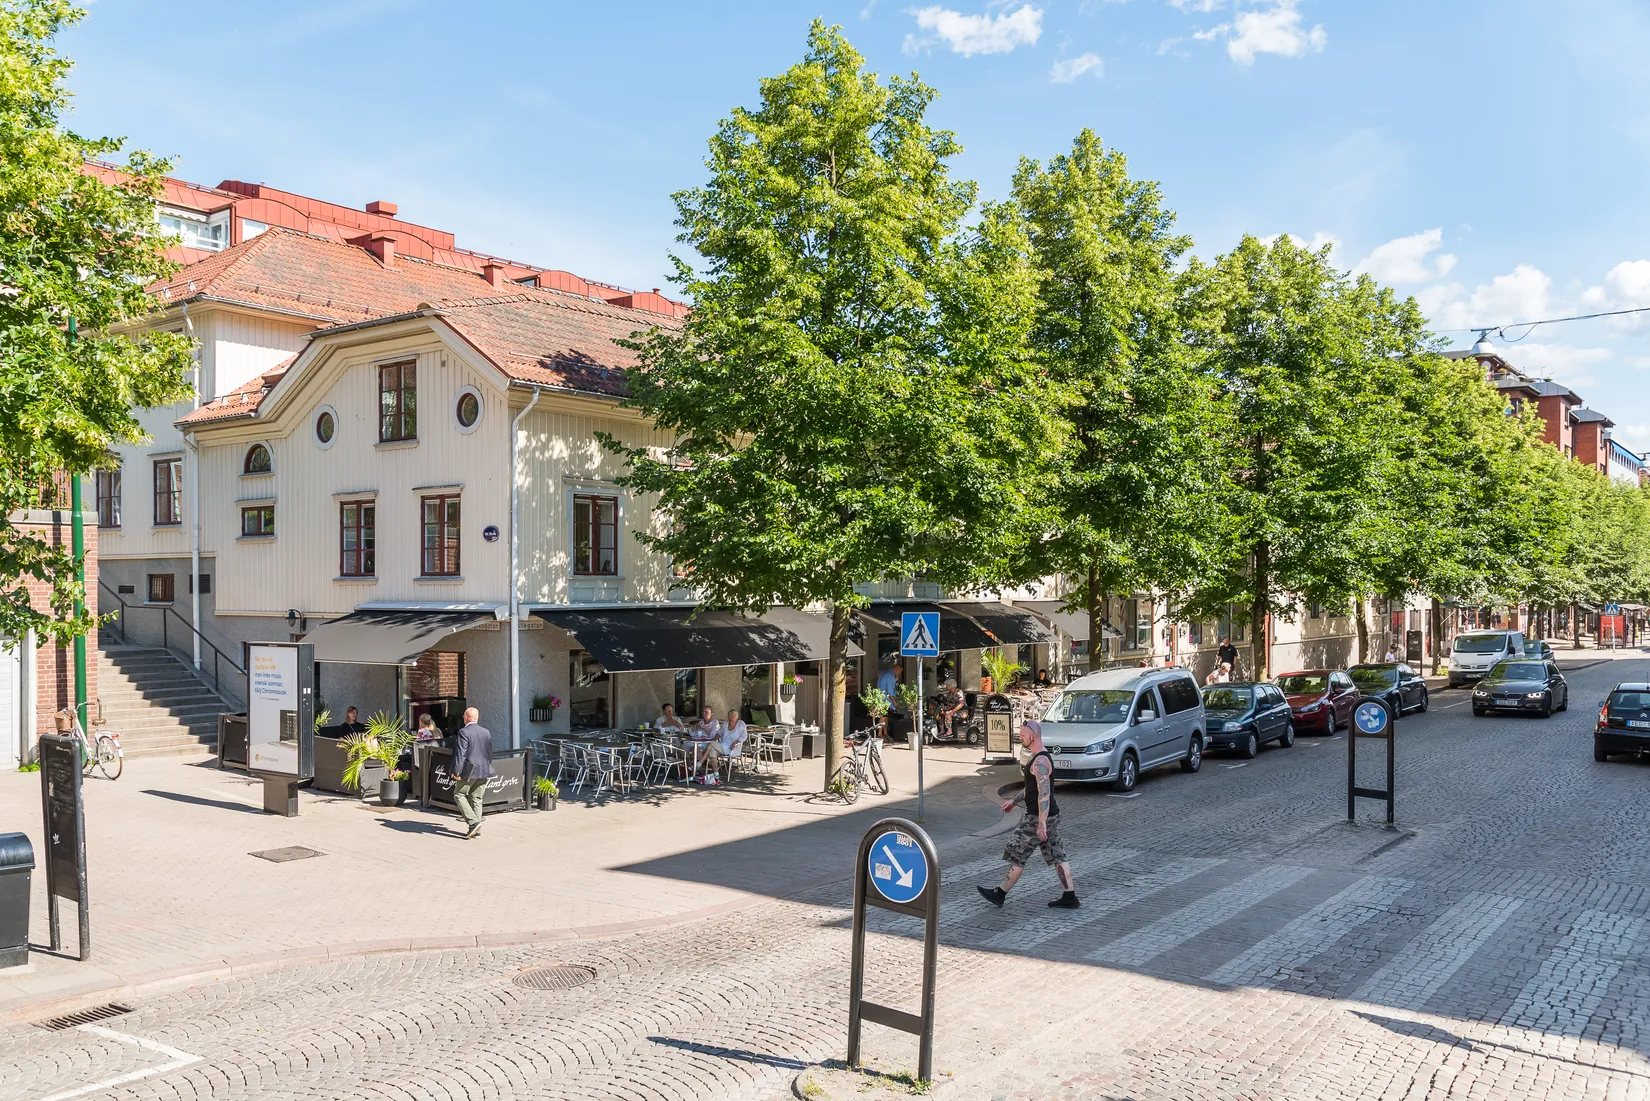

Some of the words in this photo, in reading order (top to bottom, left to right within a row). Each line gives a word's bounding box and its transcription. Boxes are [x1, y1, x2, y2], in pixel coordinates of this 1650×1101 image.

[991, 719, 1006, 731] 10%
[434, 770, 450, 785] Tant
[485, 774, 504, 789] Tant
[493, 776, 518, 792] grön
